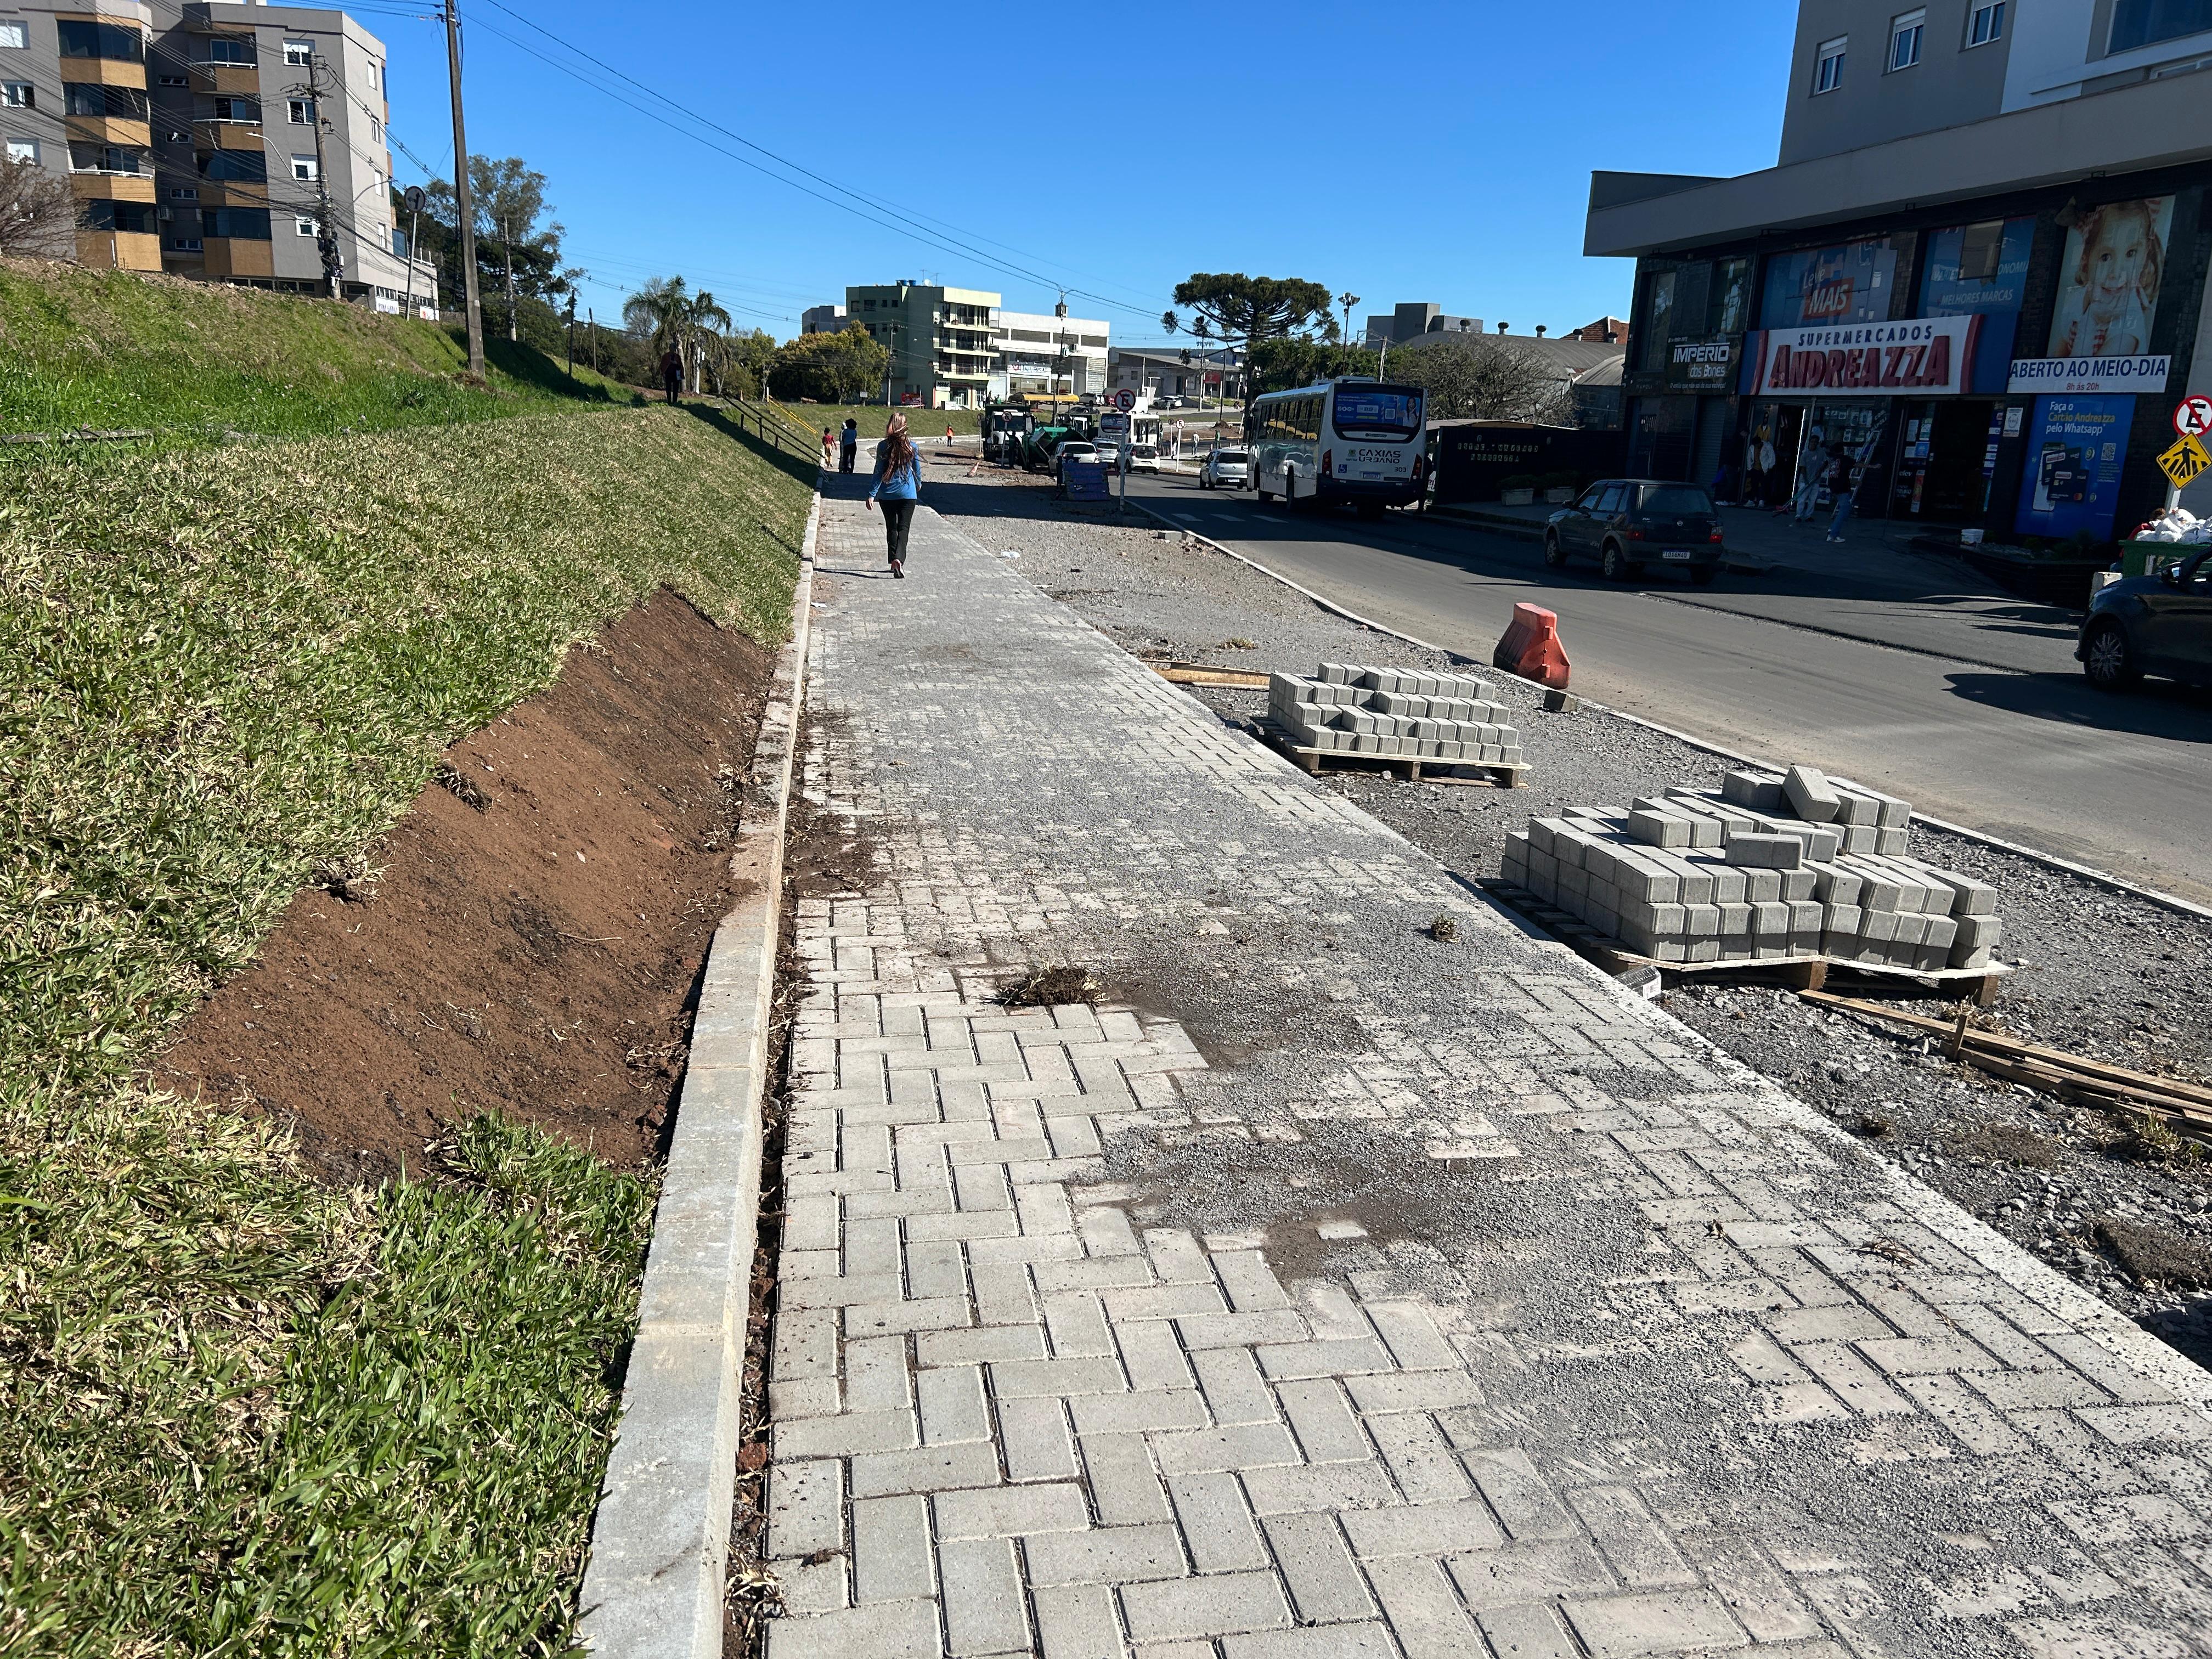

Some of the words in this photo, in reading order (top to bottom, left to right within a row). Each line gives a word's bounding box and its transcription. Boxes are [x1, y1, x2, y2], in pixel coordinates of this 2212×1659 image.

[1997, 261, 2028, 275] ONOMIA
[1803, 267, 1825, 289] Leve
[1808, 284, 1849, 315] MAIS
[1940, 291, 1980, 306] MELHORES
[1980, 289, 2014, 302] MARCAS
[1798, 325, 1933, 346] SUPERMERCADOS
[1768, 335, 1950, 387] ANDREAZZA
[2009, 360, 2064, 377] ABERTO
[2067, 360, 2089, 377] AO
[2092, 358, 2165, 376] MEIO-DIA
[1690, 364, 1702, 377] dos
[2086, 382, 2100, 390] 20h
[1122, 394, 1130, 407] E
[2049, 401, 2067, 413] Faça
[2048, 413, 2073, 422] Cartão
[2075, 413, 2115, 422] Andreazza
[2186, 403, 2207, 428] E
[2046, 423, 2063, 435] pelo
[1359, 448, 1401, 458] CAXIAS
[1358, 456, 1400, 464] URBANO
